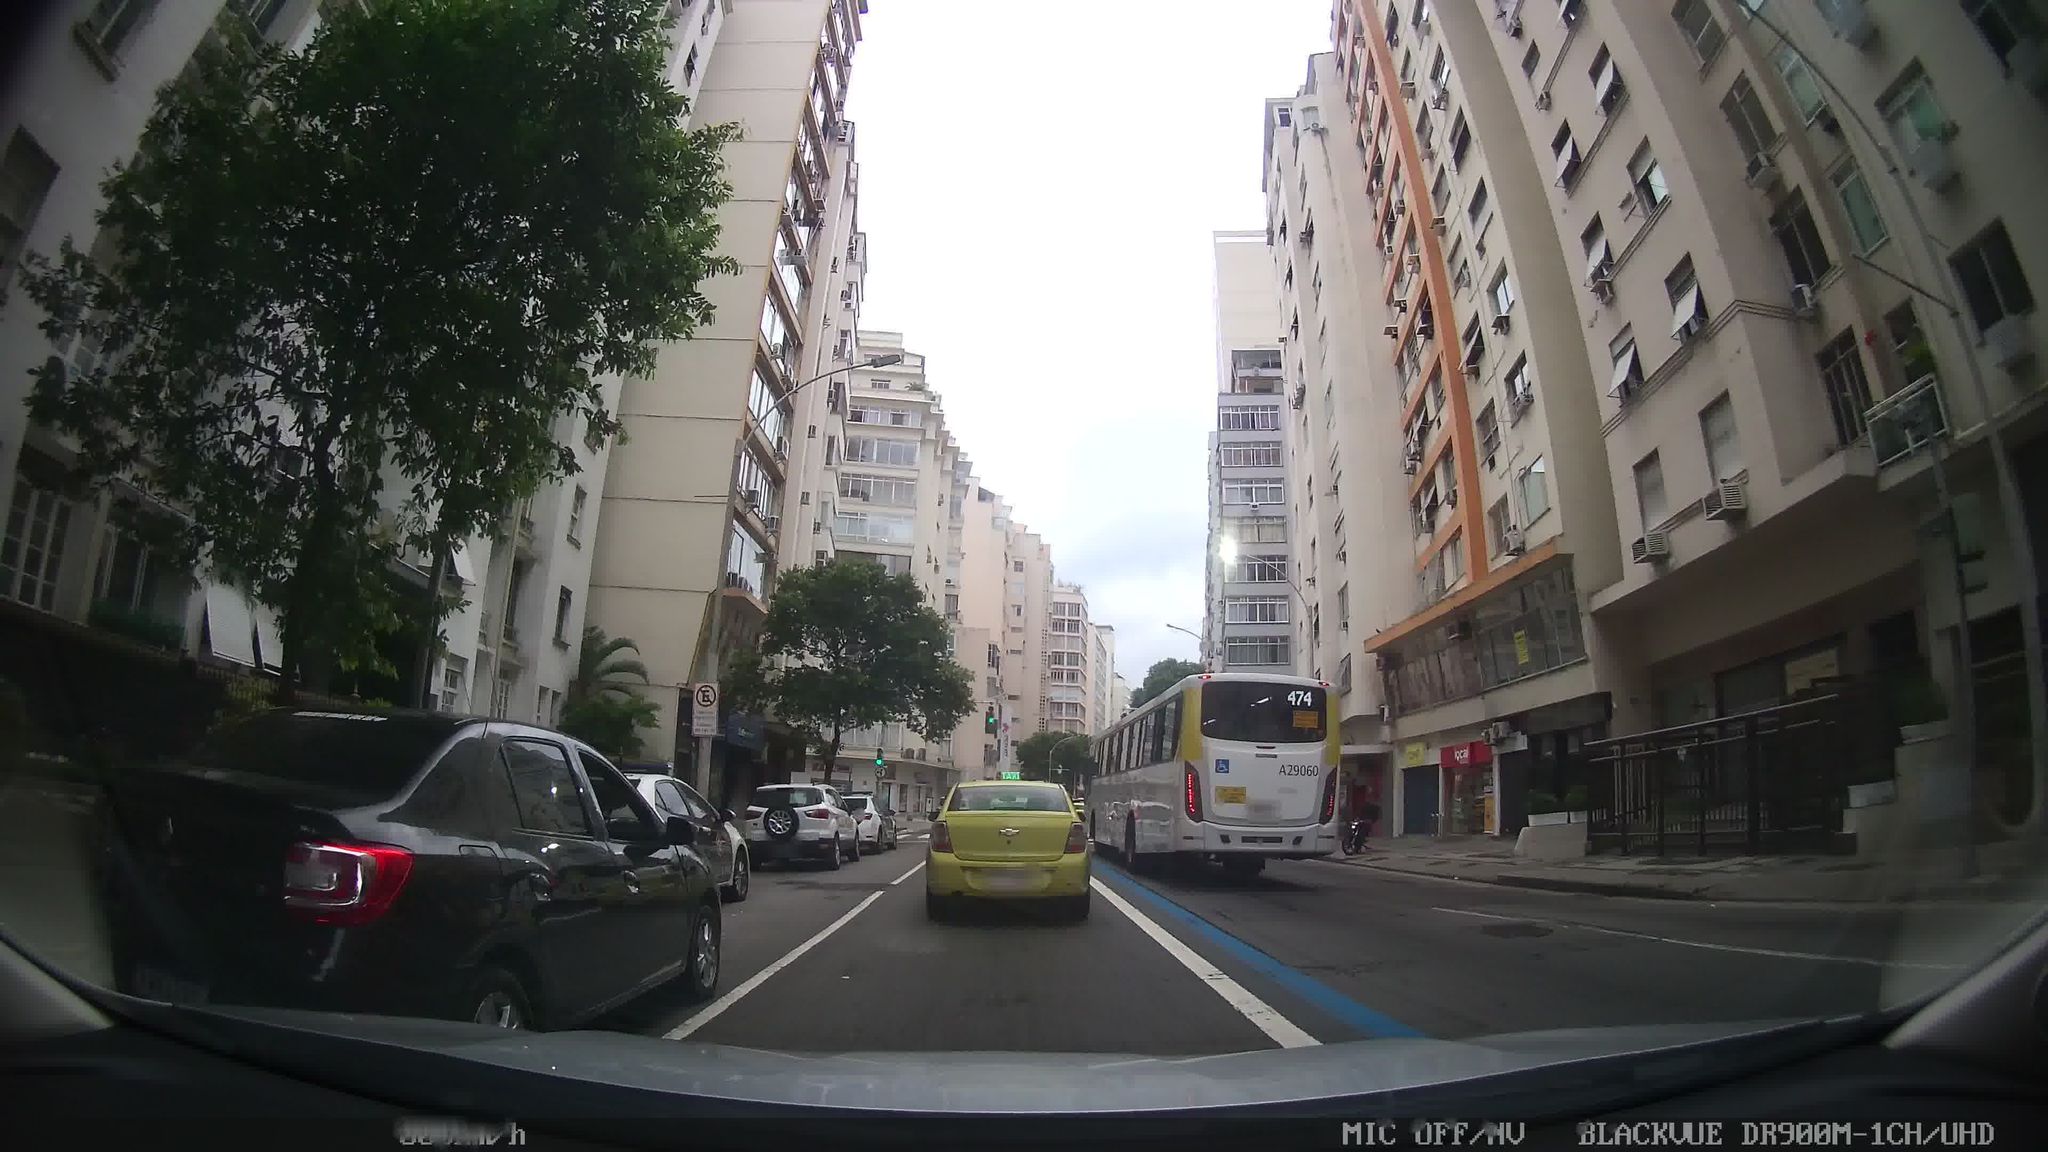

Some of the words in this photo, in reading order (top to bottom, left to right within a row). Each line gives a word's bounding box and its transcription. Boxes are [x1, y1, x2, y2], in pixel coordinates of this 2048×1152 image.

[1287, 690, 1313, 707] 474
[1002, 772, 1020, 780] TAXI
[1278, 764, 1319, 777] A29060
